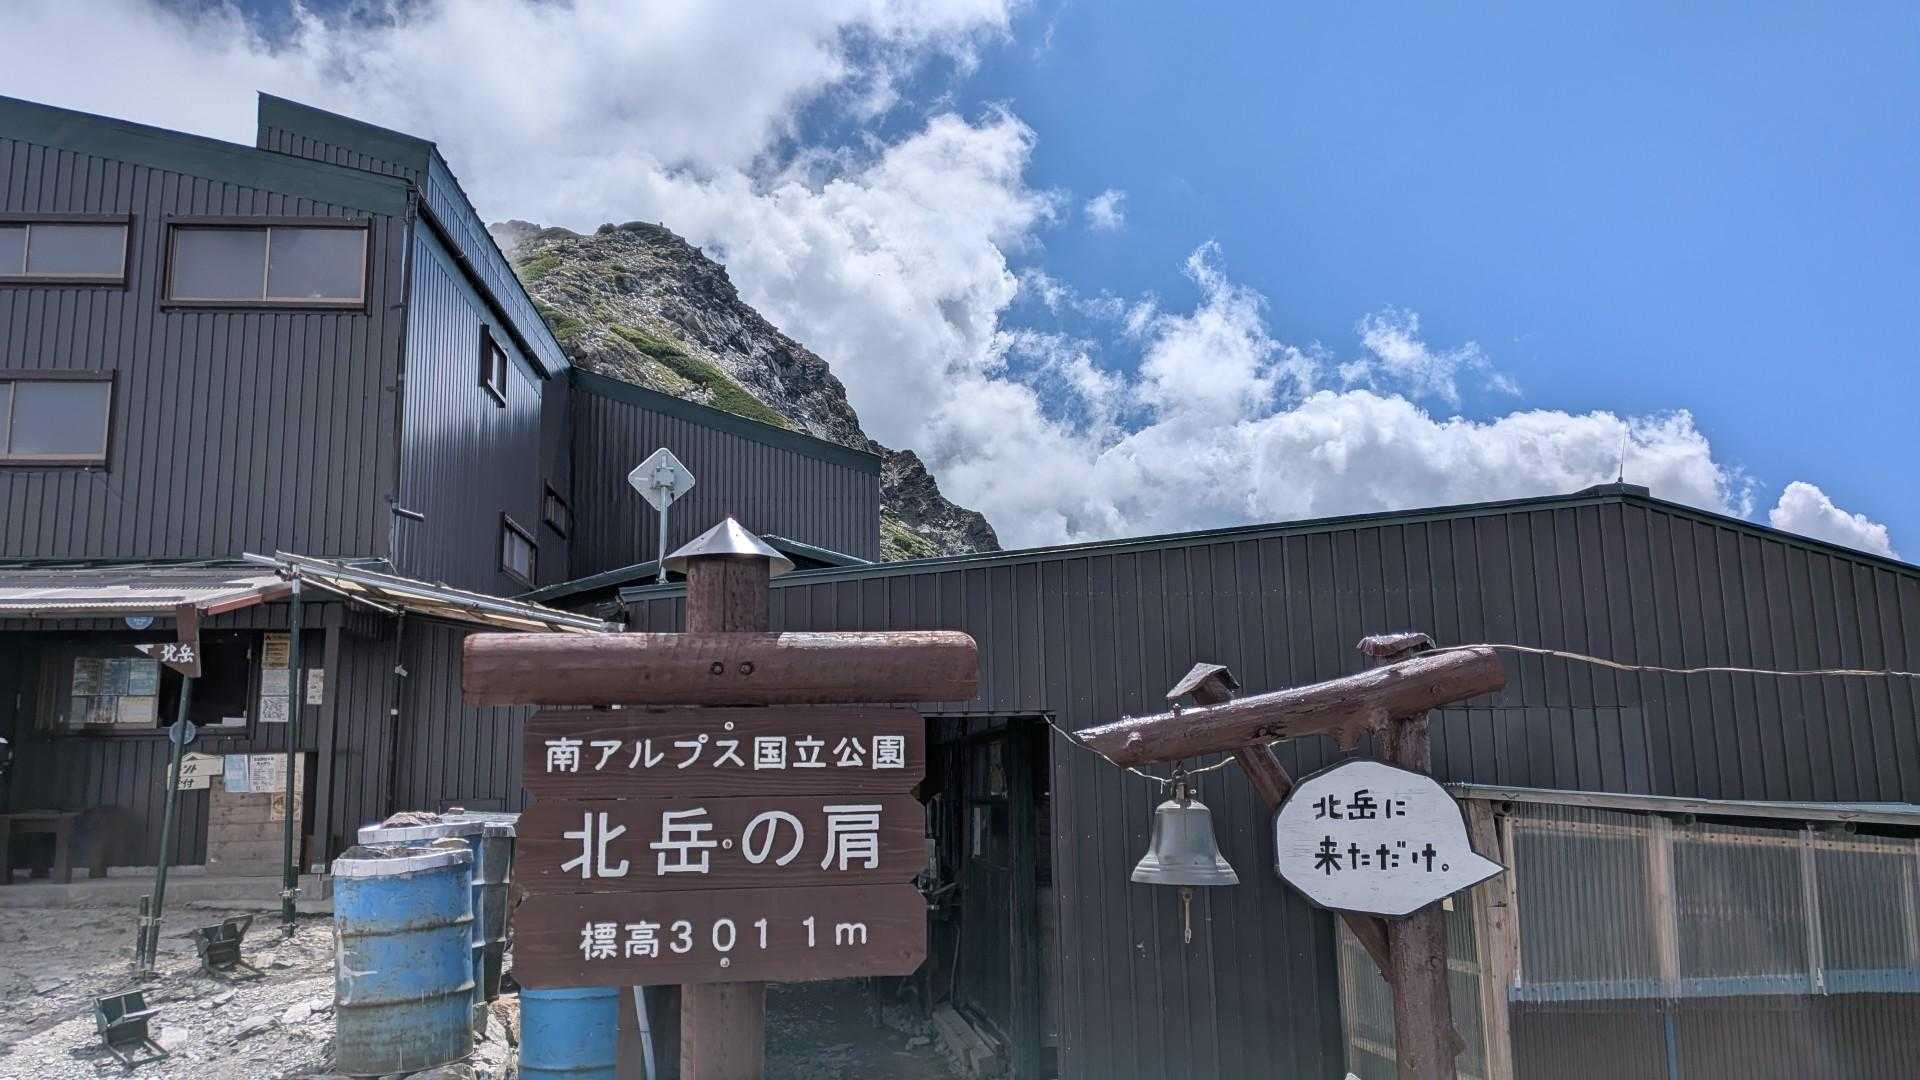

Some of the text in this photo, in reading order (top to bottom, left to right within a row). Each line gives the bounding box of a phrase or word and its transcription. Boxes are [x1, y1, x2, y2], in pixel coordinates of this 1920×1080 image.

[160, 644, 194, 663] 北岳
[545, 734, 905, 773] 南アルプス国立公園
[1312, 788, 1406, 820] 北岳に
[561, 804, 883, 879] 北岳の肩
[1314, 835, 1450, 876] 来ただけ。
[579, 916, 868, 961] 標高3011m
